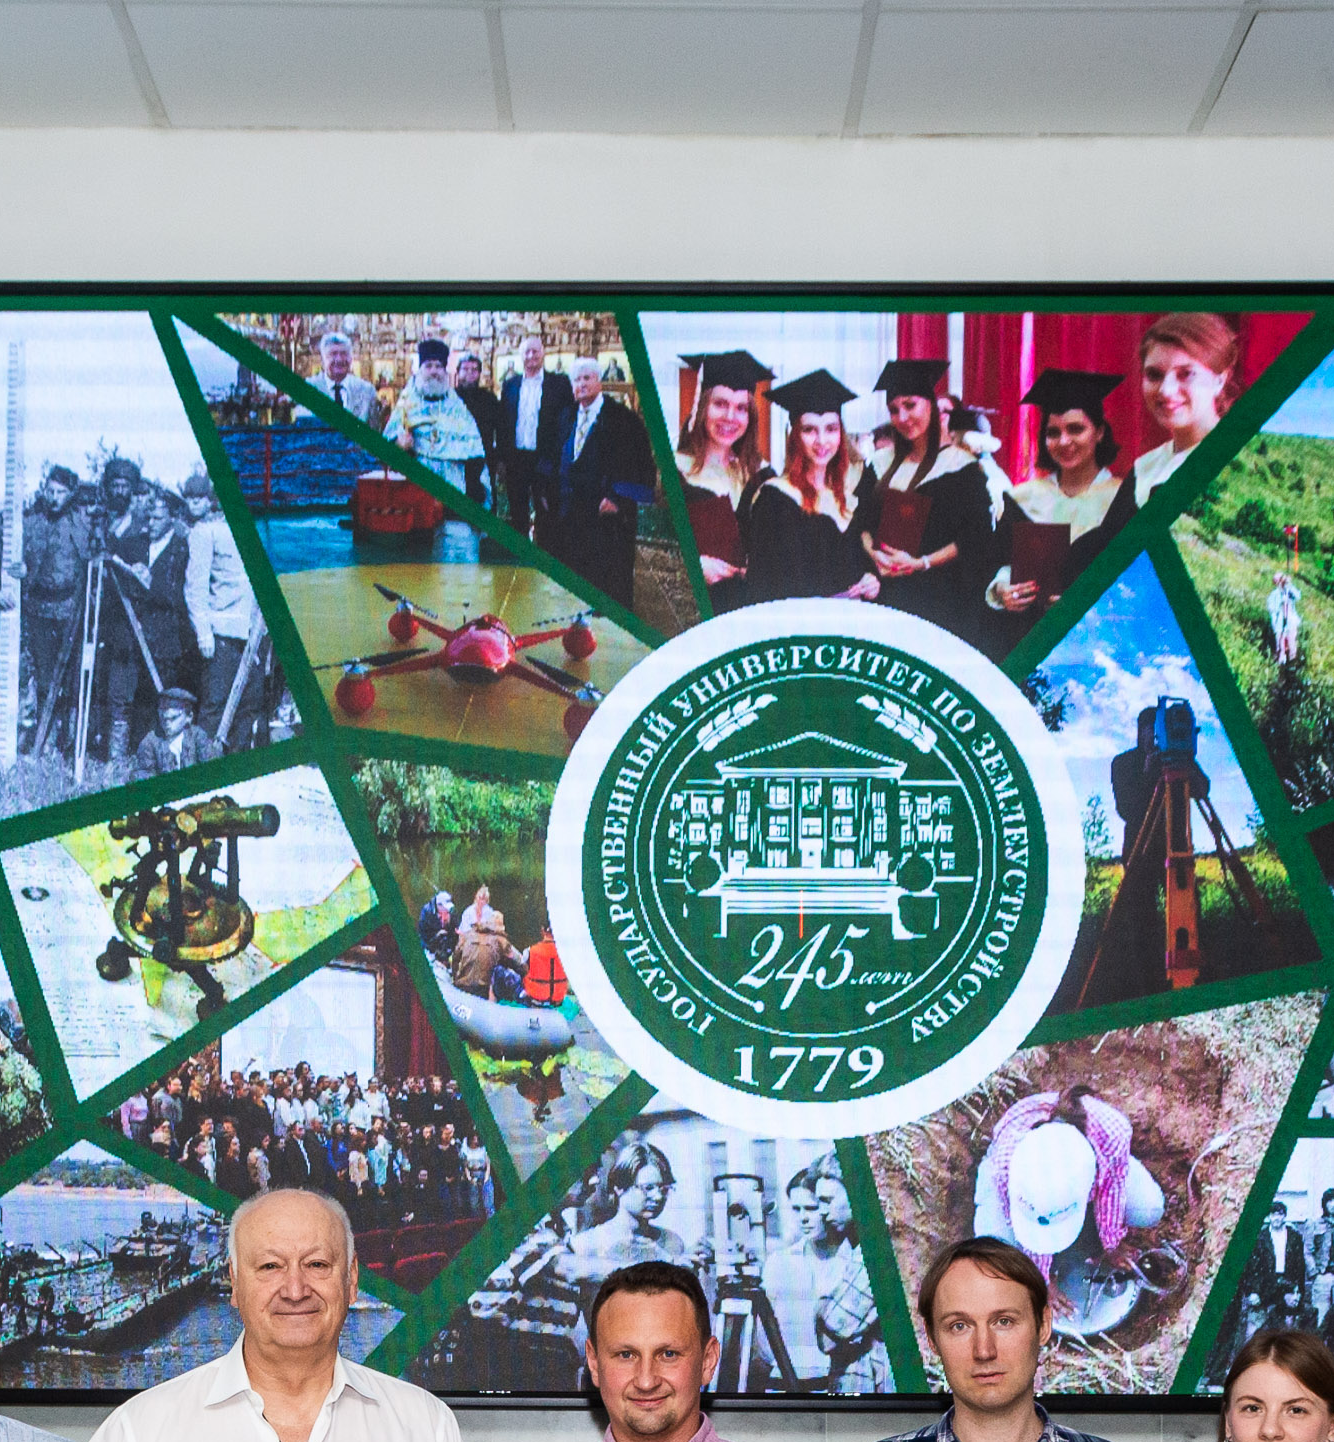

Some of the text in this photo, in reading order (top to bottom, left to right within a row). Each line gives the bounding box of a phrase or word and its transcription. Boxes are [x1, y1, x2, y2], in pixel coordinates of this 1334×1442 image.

[600, 644, 1029, 1043] ГОСУДАРСТВЕННЫЙ УНИВЕРСИТЕТ ПО ЗЕМЛЕУСТРОЙСТВУ
[734, 923, 870, 1010] 245
[733, 1045, 885, 1092] 1779
